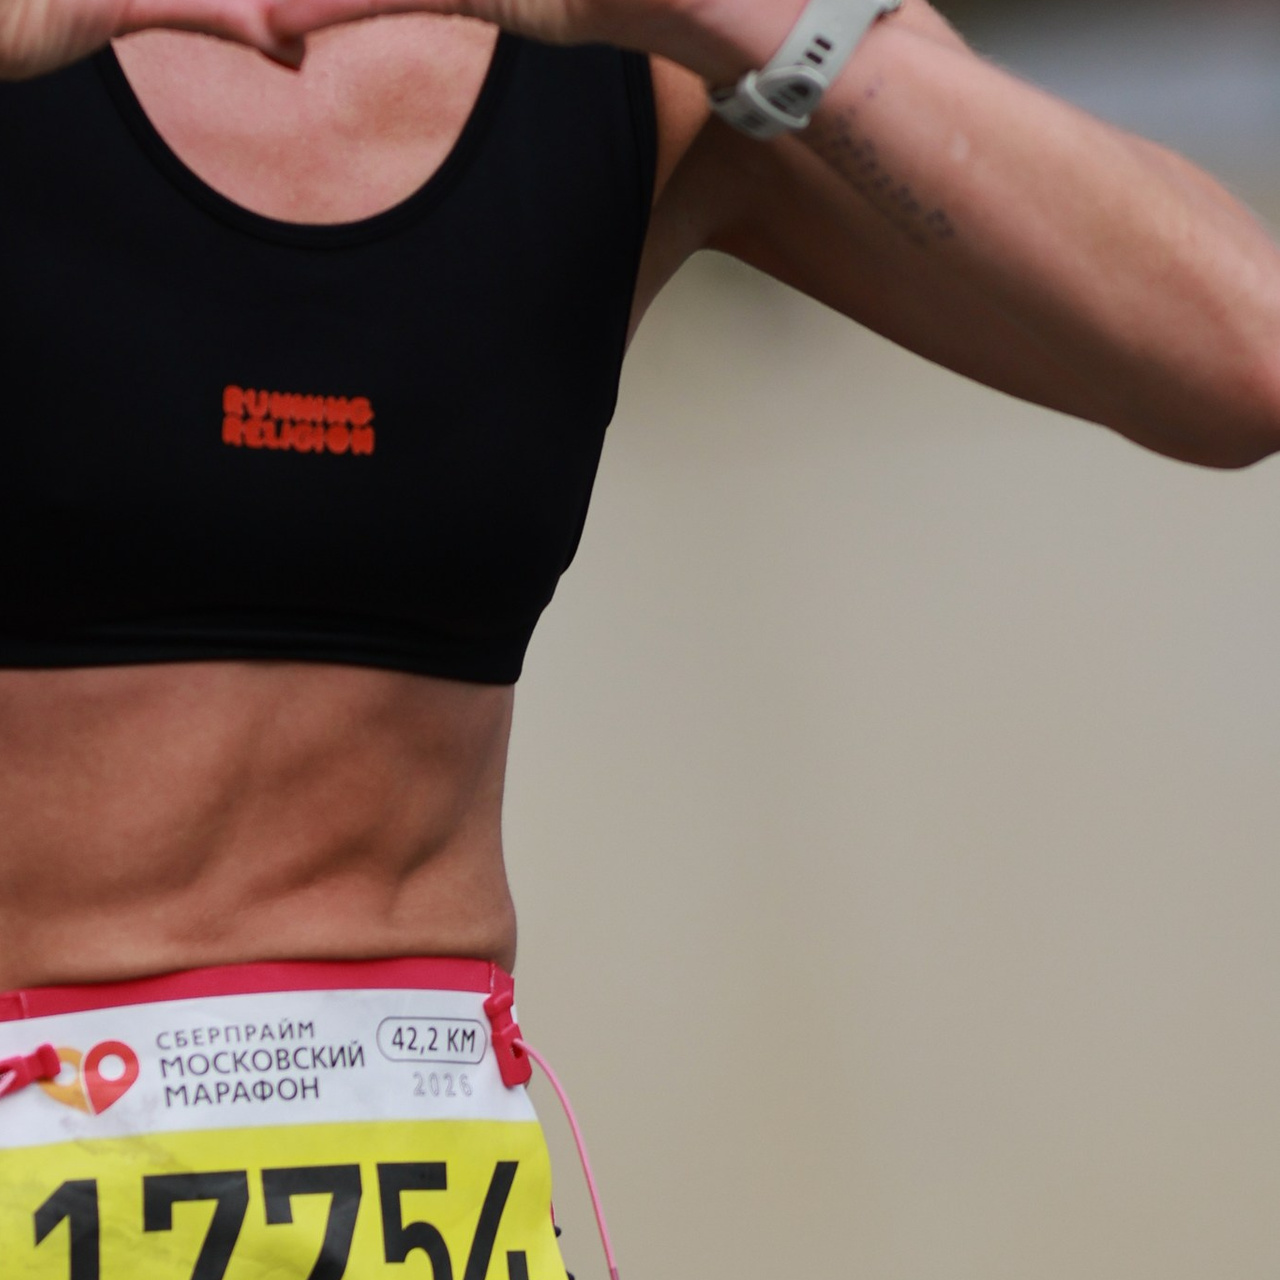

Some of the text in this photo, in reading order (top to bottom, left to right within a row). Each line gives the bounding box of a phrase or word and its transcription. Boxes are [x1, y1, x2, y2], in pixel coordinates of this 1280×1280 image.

[156, 1018, 315, 1050] СБЕРПРАЙМ
[392, 1026, 438, 1055] 42,2
[160, 1040, 365, 1078] МОСКОВСКИЙ
[165, 1077, 319, 1107] МАРАФОН
[413, 1071, 472, 1097] 2026
